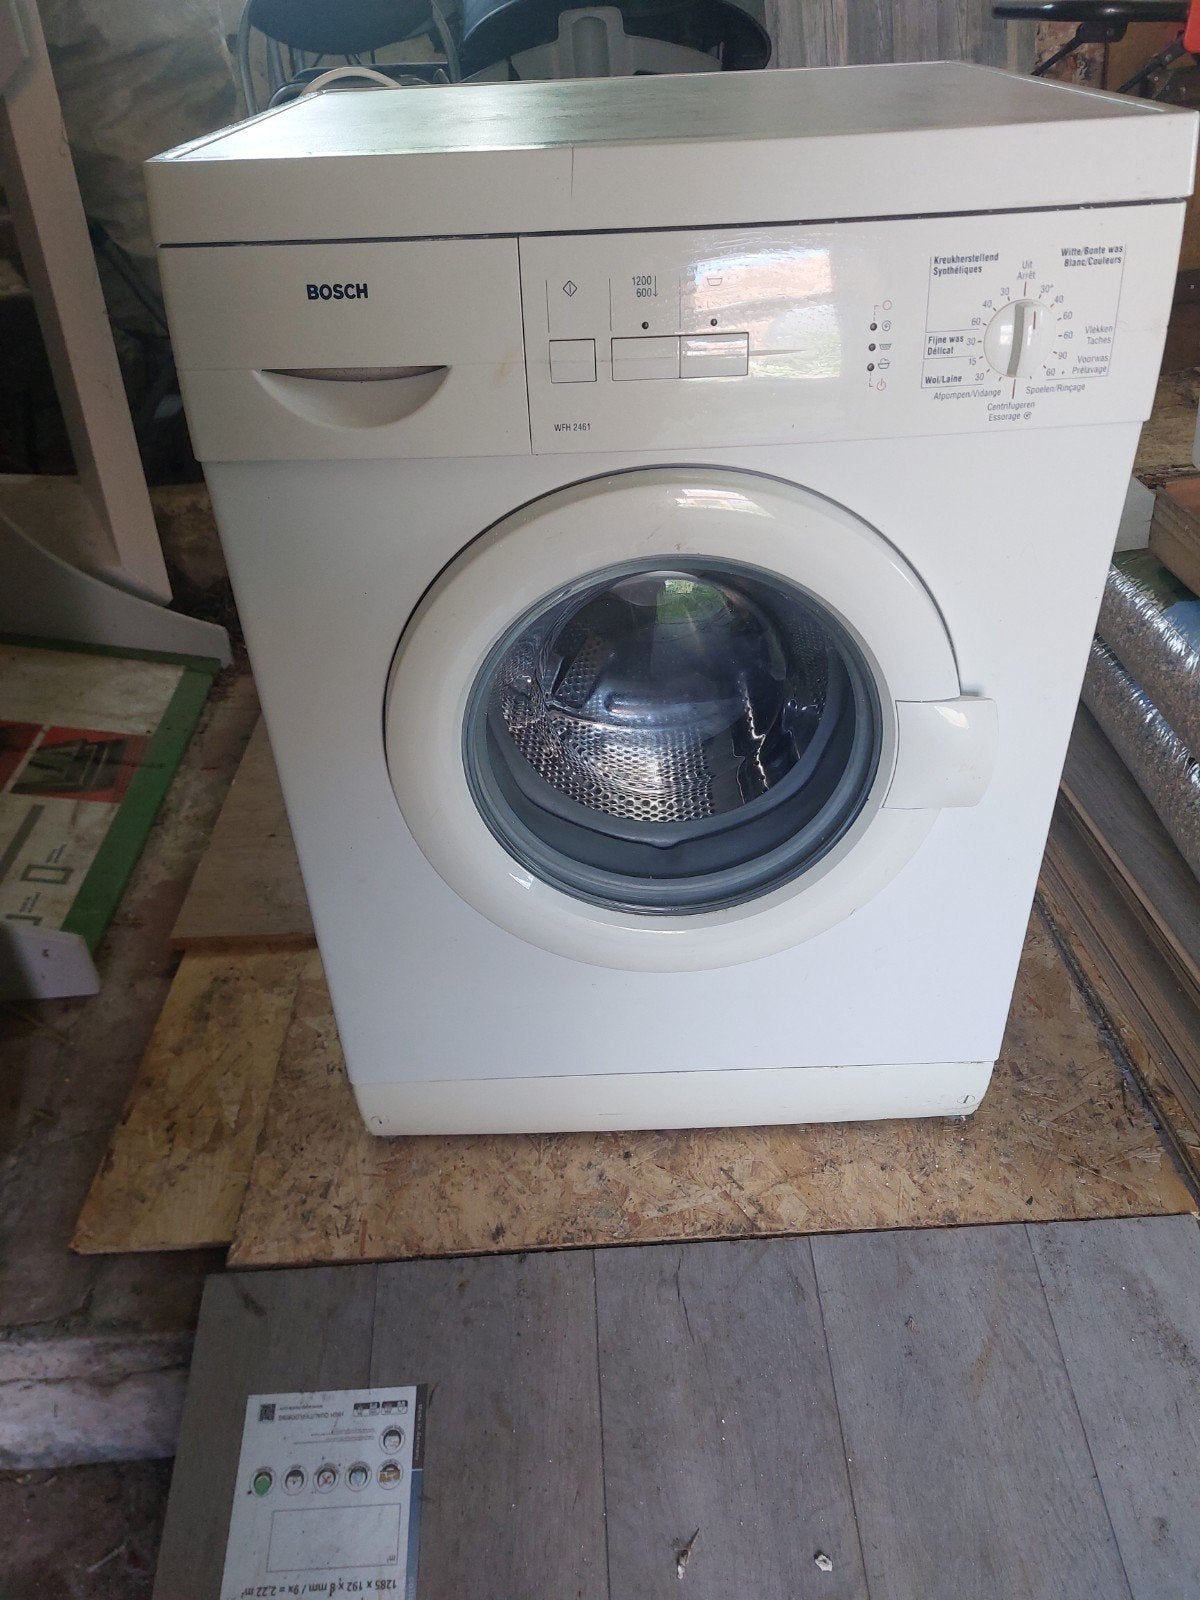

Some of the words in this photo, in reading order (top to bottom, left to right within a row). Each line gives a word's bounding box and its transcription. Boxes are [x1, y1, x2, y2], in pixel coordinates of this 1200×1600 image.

[1061, 246, 1107, 257] Witte/Bonte
[1108, 245, 1124, 254] was
[933, 253, 999, 265] Kreukherstellend
[1064, 256, 1122, 267] Blanc/Couleurs
[1022, 260, 1033, 269] Uit
[933, 265, 983, 277] Synthétiques
[1017, 270, 1036, 280] Arrêt
[632, 276, 652, 286] 1200
[306, 283, 369, 300] BOSCH
[636, 288, 652, 297] 600
[1000, 287, 1010, 296] 30
[982, 300, 993, 308] 40
[1054, 295, 1064, 304] 40
[1063, 311, 1073, 320] 60
[971, 317, 982, 326] 60
[1085, 325, 1113, 334] Vlekken
[928, 335, 948, 345] Fijne
[949, 335, 964, 343] was
[1063, 331, 1073, 340] 60
[966, 337, 976, 346] 30
[1086, 336, 1112, 345] Taches
[927, 346, 954, 355] Délicat
[1058, 351, 1068, 360] 90
[1077, 354, 1109, 363] Voorwas
[969, 358, 977, 366] 15
[1046, 368, 1056, 377] 60
[1072, 365, 1107, 375] Prélavage
[925, 375, 962, 384] Wol/Laine
[975, 373, 985, 381] 30
[1026, 383, 1086, 395] Spoelen/Rinçage
[933, 389, 1002, 401] Afpompen/Vidange
[987, 401, 1035, 411] Centrifugeren
[988, 412, 1021, 422] Essorage
[553, 423, 571, 432] WFH
[573, 422, 591, 432] 2461
[308, 1583, 327, 1592] mm
[346, 1581, 363, 1591] 192
[375, 1579, 396, 1591] 1285
[288, 1585, 299, 1595] 9x
